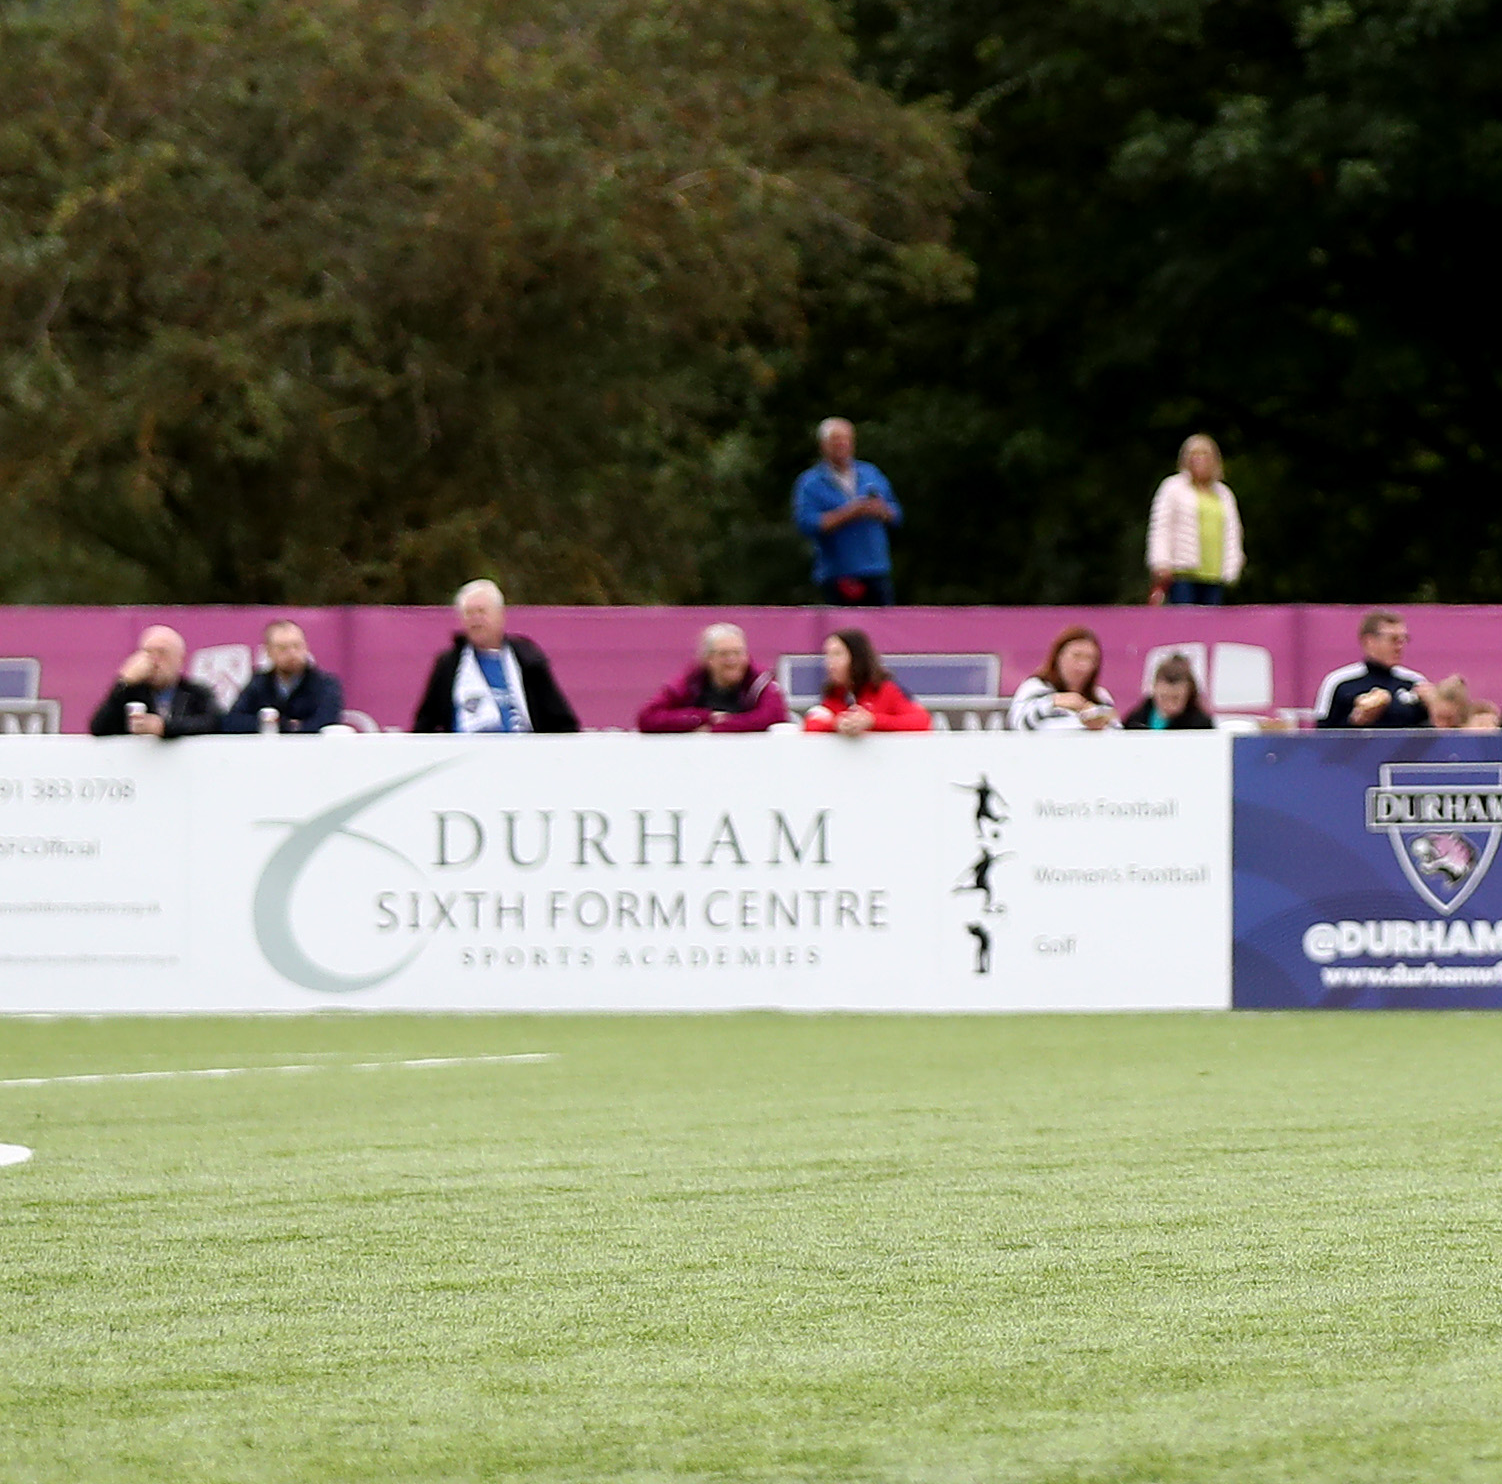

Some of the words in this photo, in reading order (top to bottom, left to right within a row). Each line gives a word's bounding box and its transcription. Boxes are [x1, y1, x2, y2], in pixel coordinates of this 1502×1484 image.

[431, 809, 834, 867] DURHAM
[376, 889, 527, 931] SIXTH
[549, 889, 689, 931] FORM
[704, 889, 891, 931] CENTRE
[461, 945, 596, 967] SPORTS
[615, 945, 823, 967] ACADEMIES
